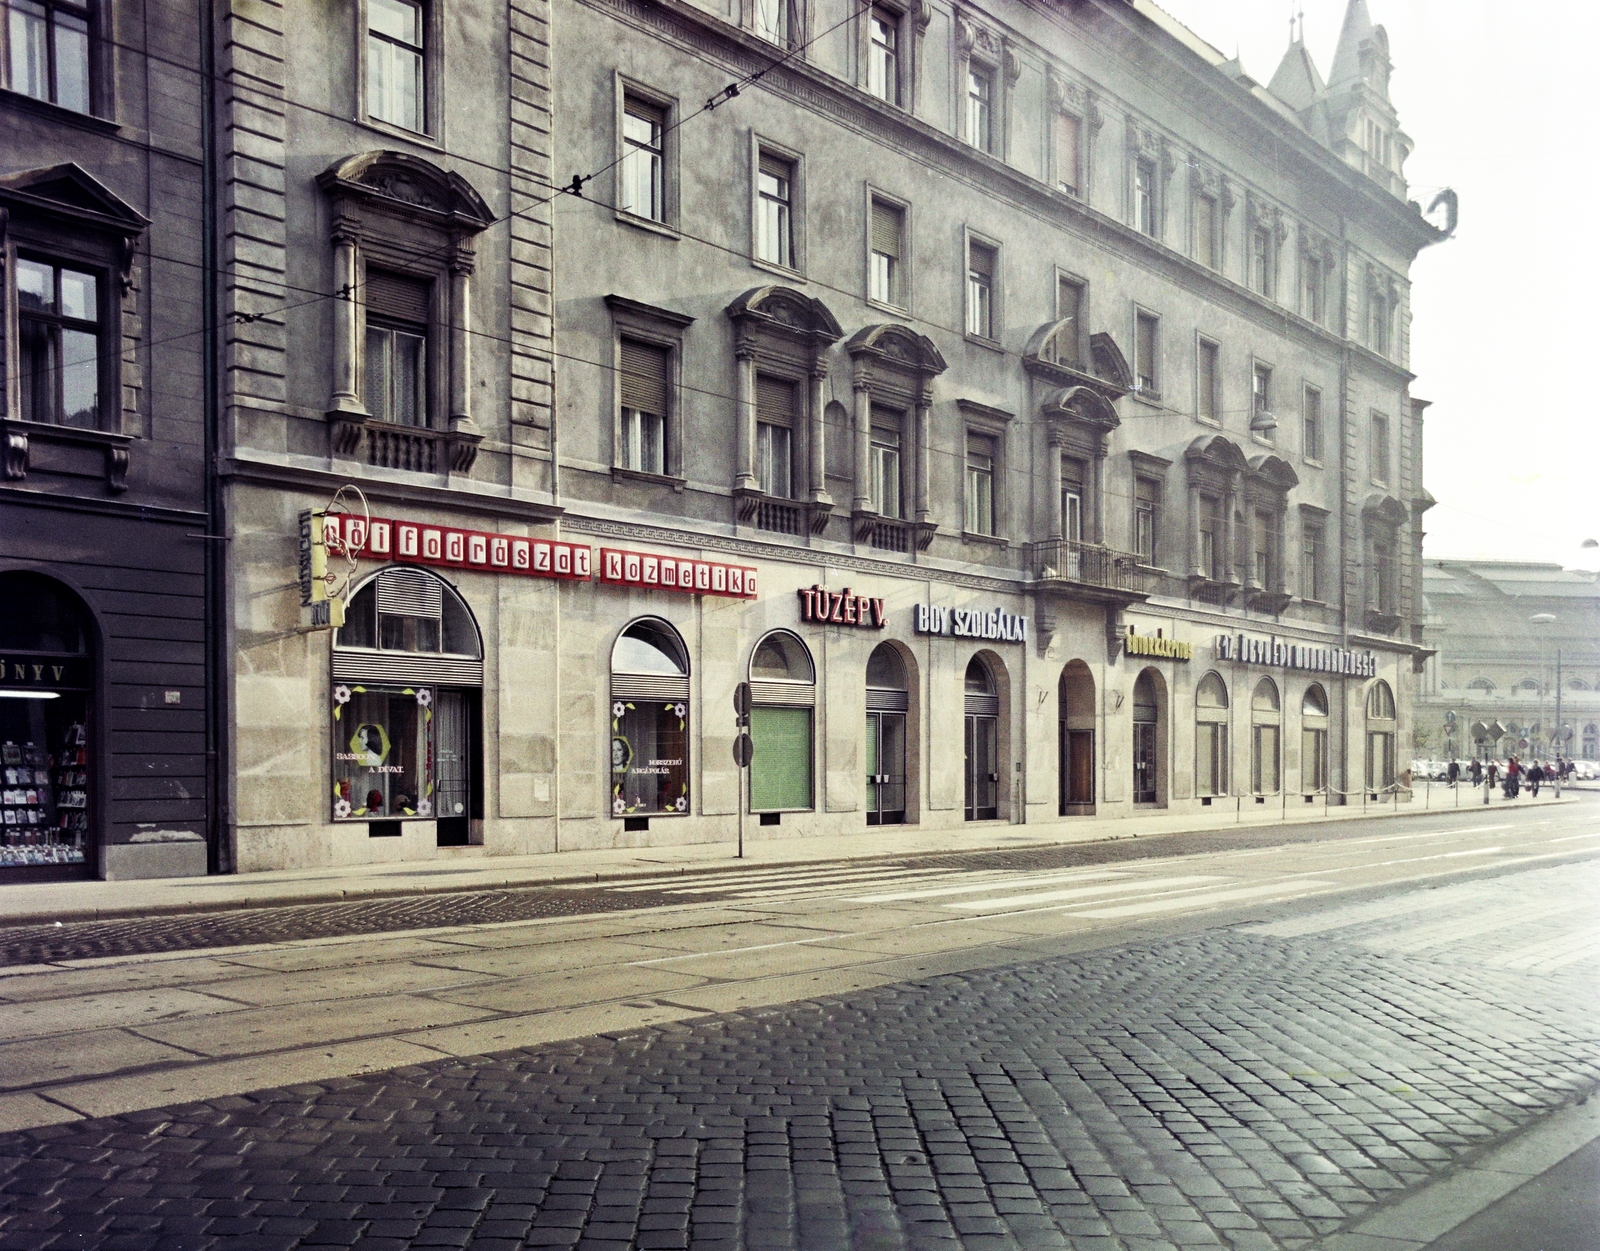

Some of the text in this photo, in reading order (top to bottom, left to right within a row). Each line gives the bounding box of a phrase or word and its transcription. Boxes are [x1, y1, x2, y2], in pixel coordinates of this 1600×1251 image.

[405, 527, 588, 573] fodrászat
[610, 554, 757, 592] kozmetika
[799, 584, 871, 625] TÜZÉP
[917, 603, 1029, 642] BOY SZOLGÁLAT
[336, 752, 376, 761] SASSOON
[368, 766, 375, 774] A
